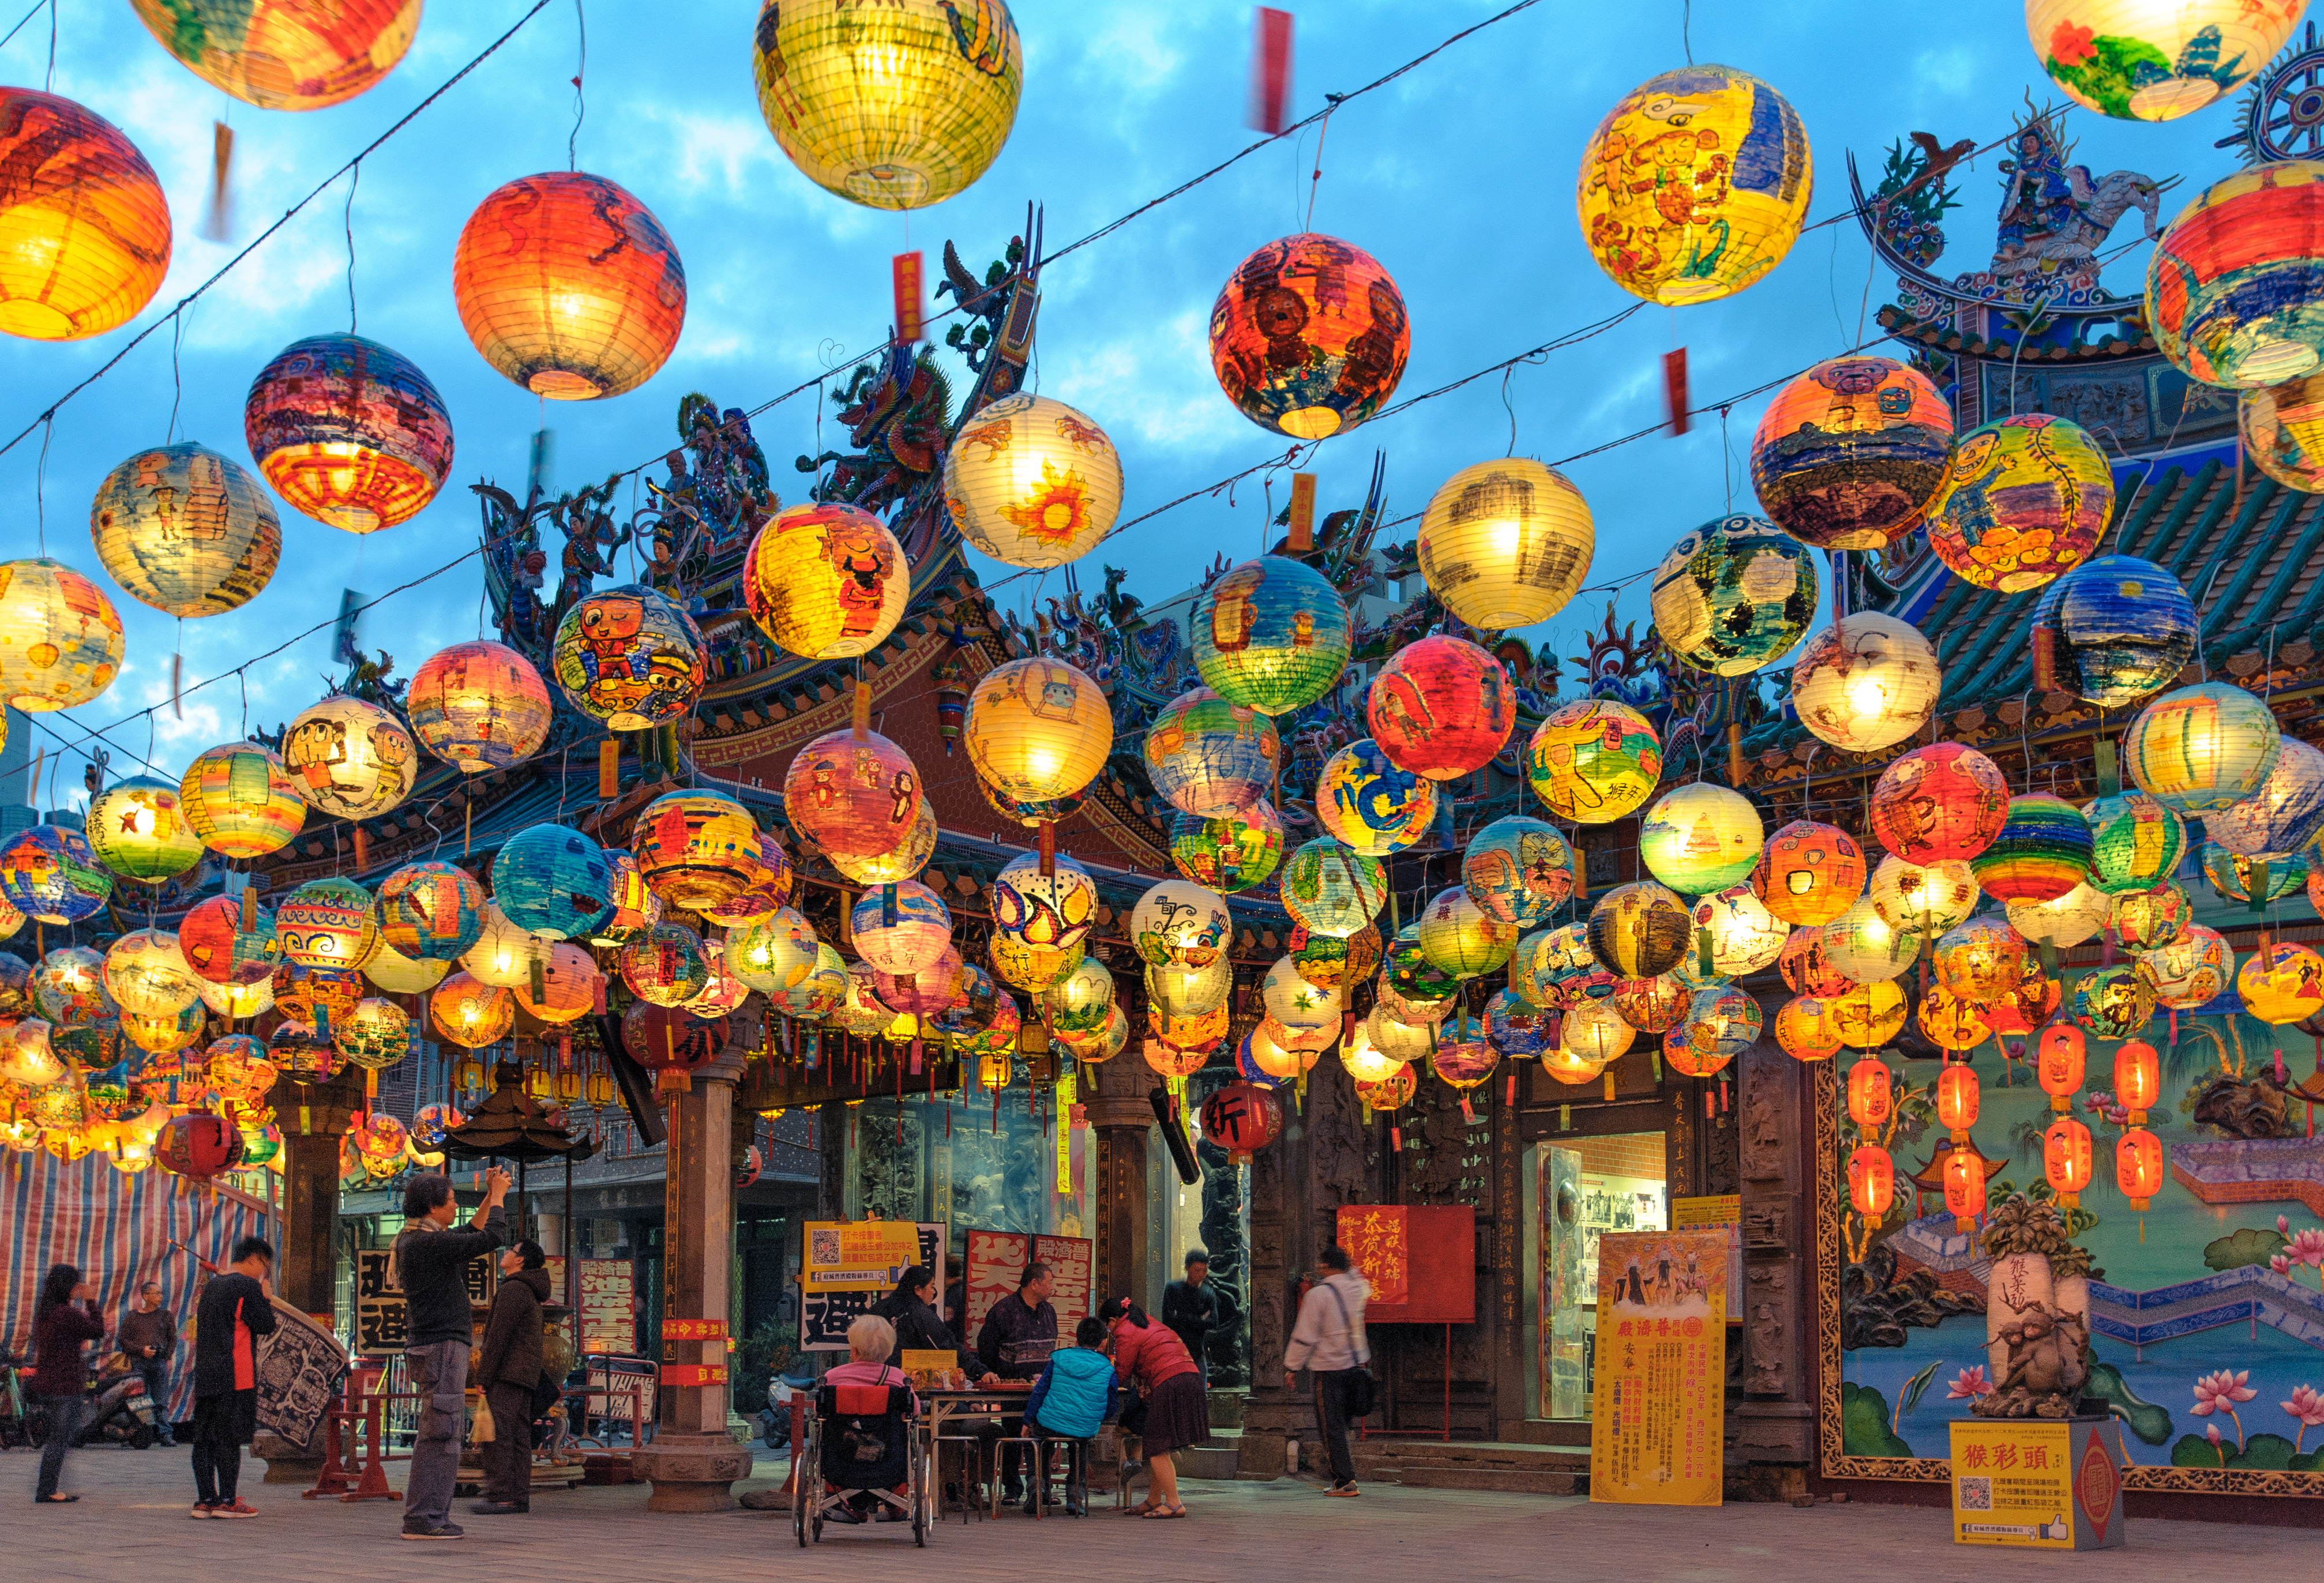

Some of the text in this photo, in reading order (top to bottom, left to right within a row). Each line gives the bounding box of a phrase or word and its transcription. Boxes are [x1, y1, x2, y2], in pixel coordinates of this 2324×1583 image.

[606, 746, 614, 794] 國小中年級組
[1205, 1093, 1247, 1143] 新
[1617, 1317, 1671, 1337] 普濟殿
[1622, 1341, 1635, 1369] 安奉
[1962, 1443, 2049, 1471] 猴彩頭
